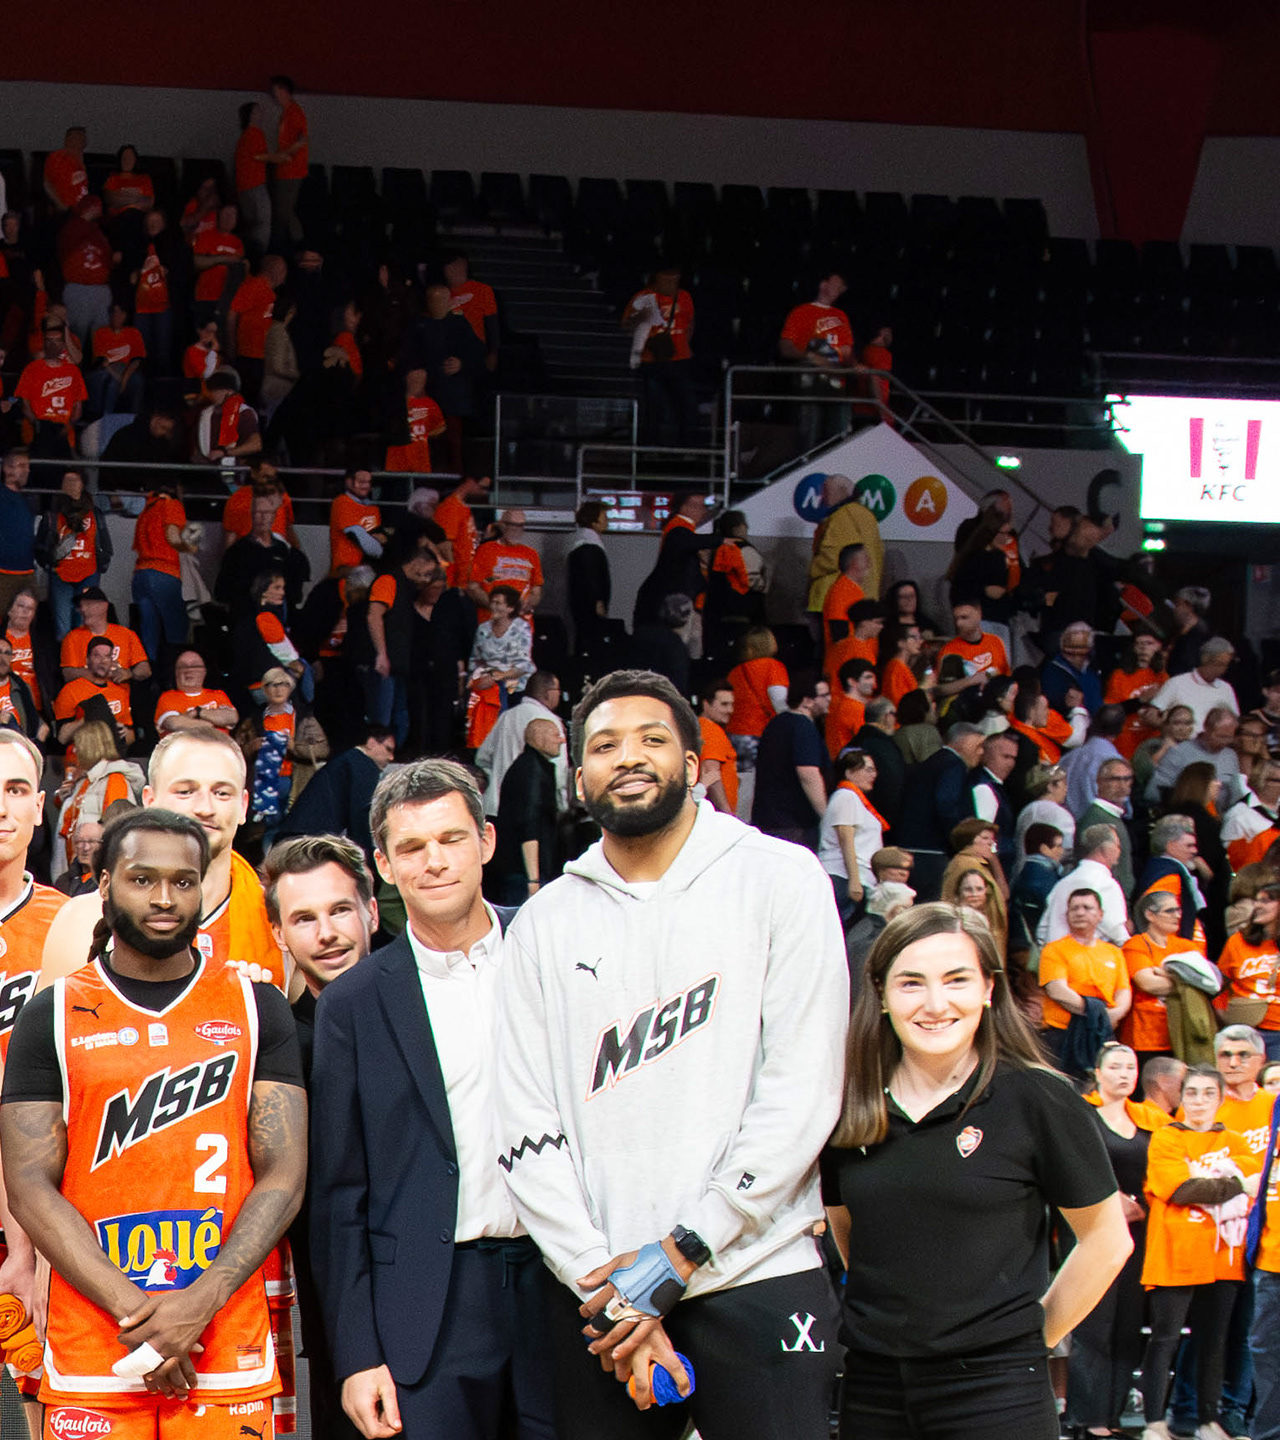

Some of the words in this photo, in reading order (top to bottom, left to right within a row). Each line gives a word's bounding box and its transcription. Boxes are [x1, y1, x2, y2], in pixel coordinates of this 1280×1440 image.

[1200, 484, 1246, 502] KFC
[203, 1022, 243, 1039] Gaulois
[588, 974, 720, 1098] MSB
[90, 1049, 239, 1173] MSB
[194, 1133, 229, 1195] 2
[104, 1206, 222, 1272] Loué
[54, 1410, 112, 1436] Gaulois
[229, 1400, 264, 1417] Rapin
